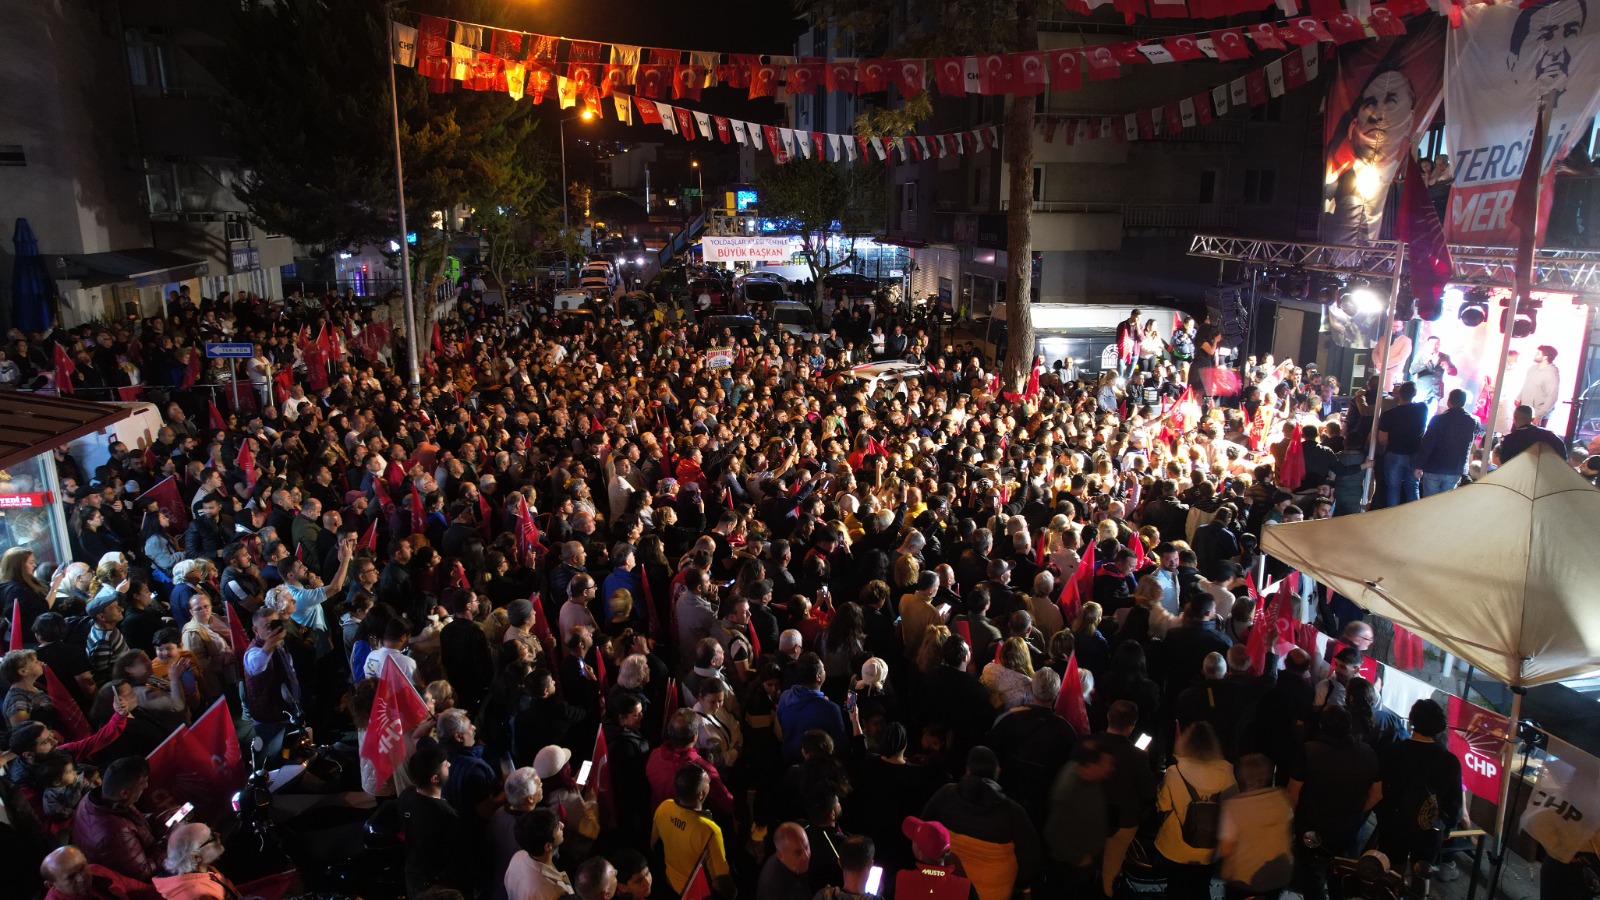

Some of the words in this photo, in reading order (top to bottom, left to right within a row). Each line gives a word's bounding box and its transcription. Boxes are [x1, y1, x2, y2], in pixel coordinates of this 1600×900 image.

[398, 41, 414, 50] CHP
[718, 247, 747, 257] BÜYÜK
[749, 248, 783, 258] BAŞKAN
[1464, 753, 1497, 778] CHP
[921, 868, 946, 877] MUSTO
